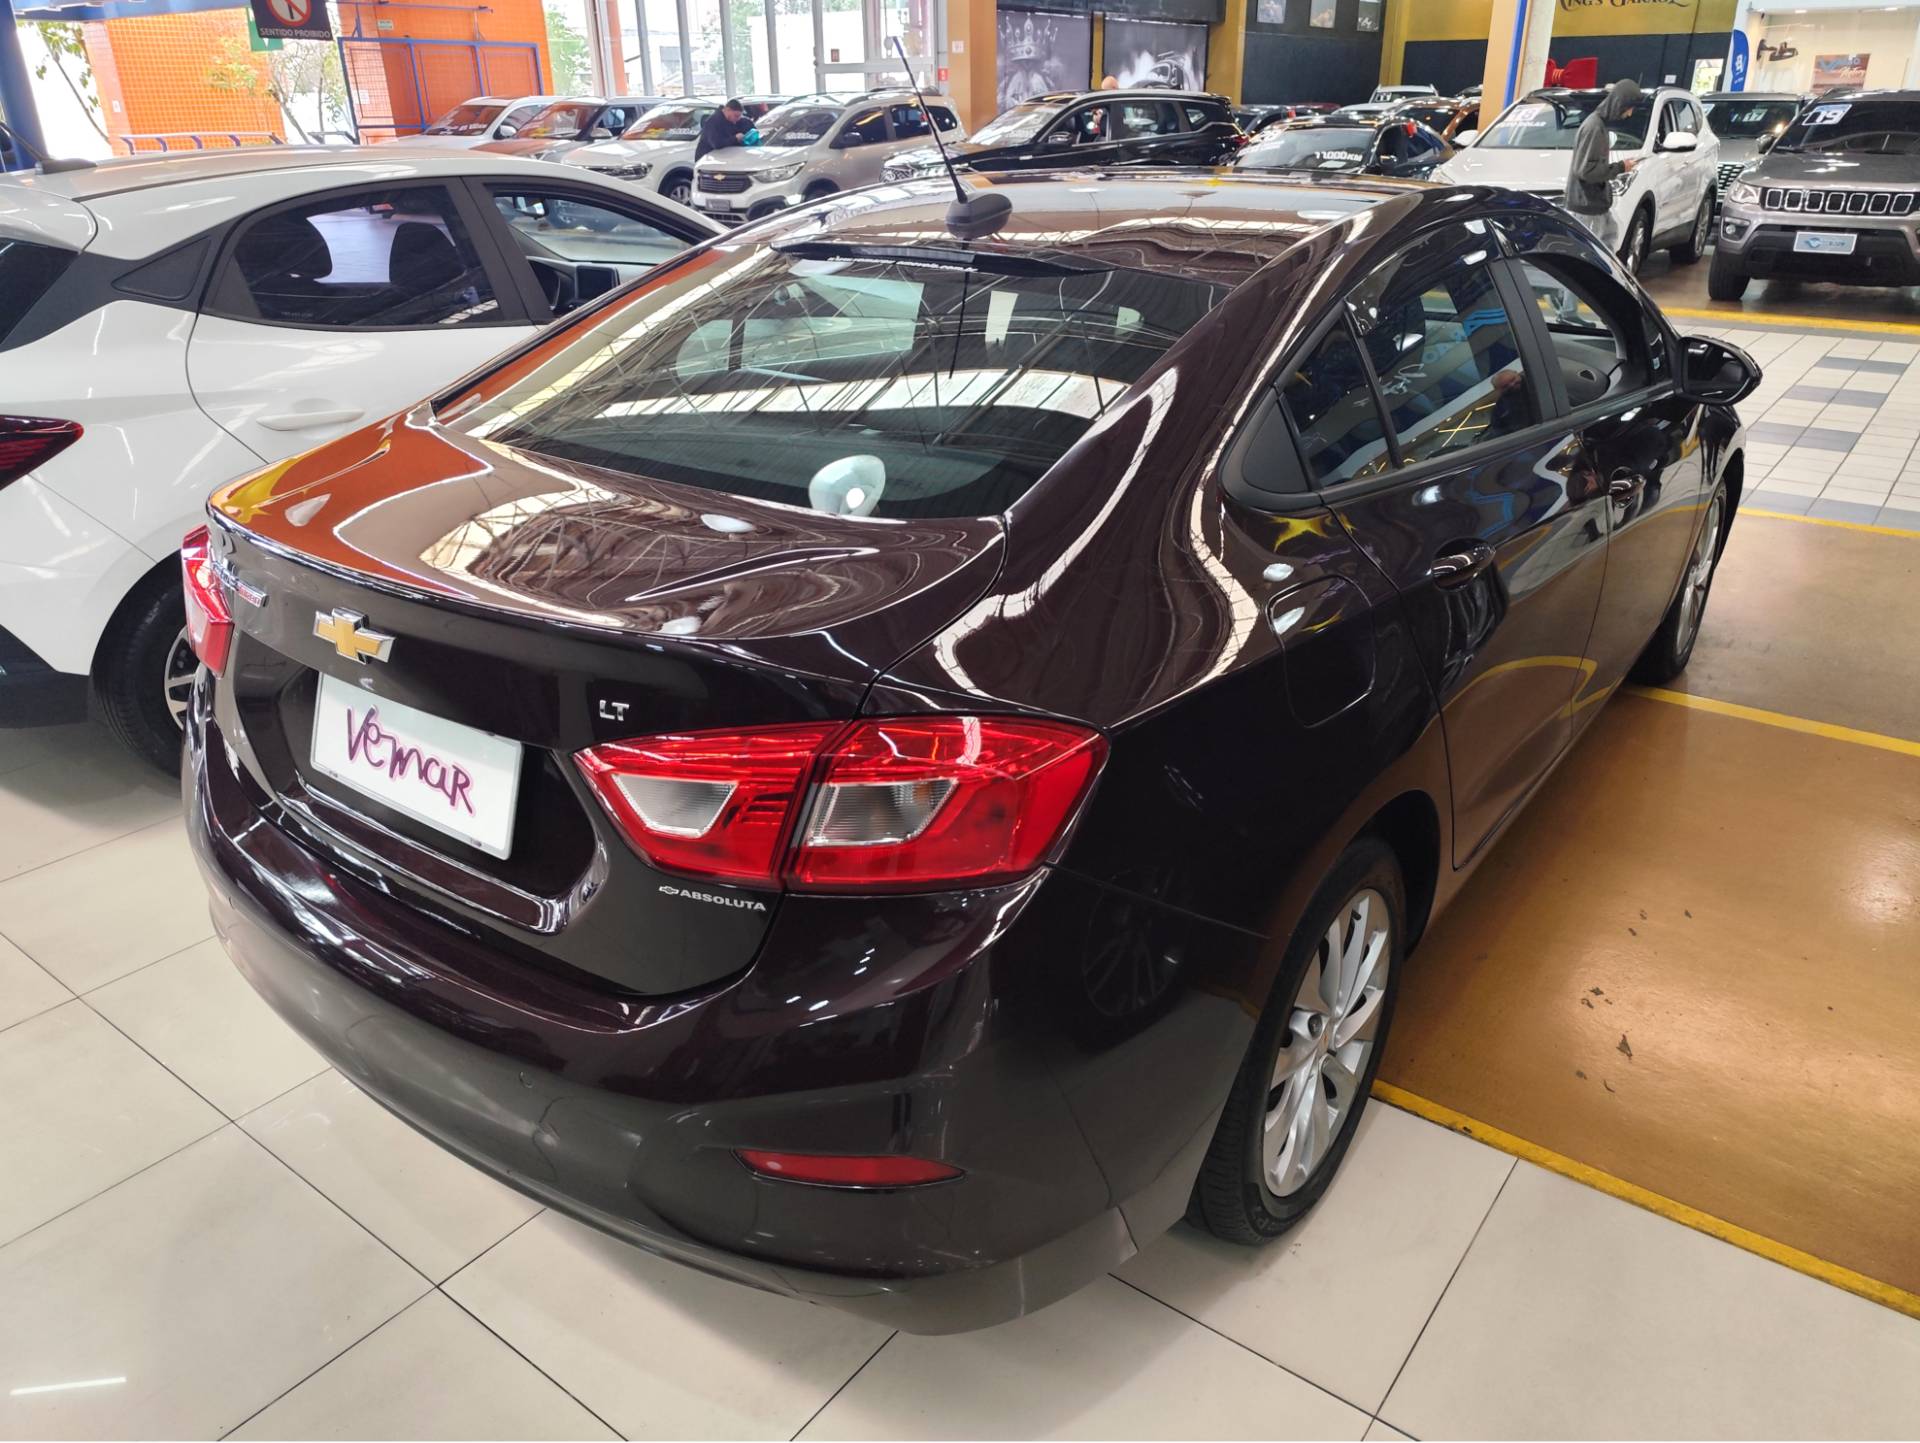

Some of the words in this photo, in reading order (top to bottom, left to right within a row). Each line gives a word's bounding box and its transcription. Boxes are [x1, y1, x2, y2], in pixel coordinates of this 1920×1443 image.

[259, 27, 293, 37] SENTIDO
[294, 29, 331, 39] PROIBIDO
[600, 700, 630, 721] LT
[680, 888, 766, 911] ABSOLUTA
